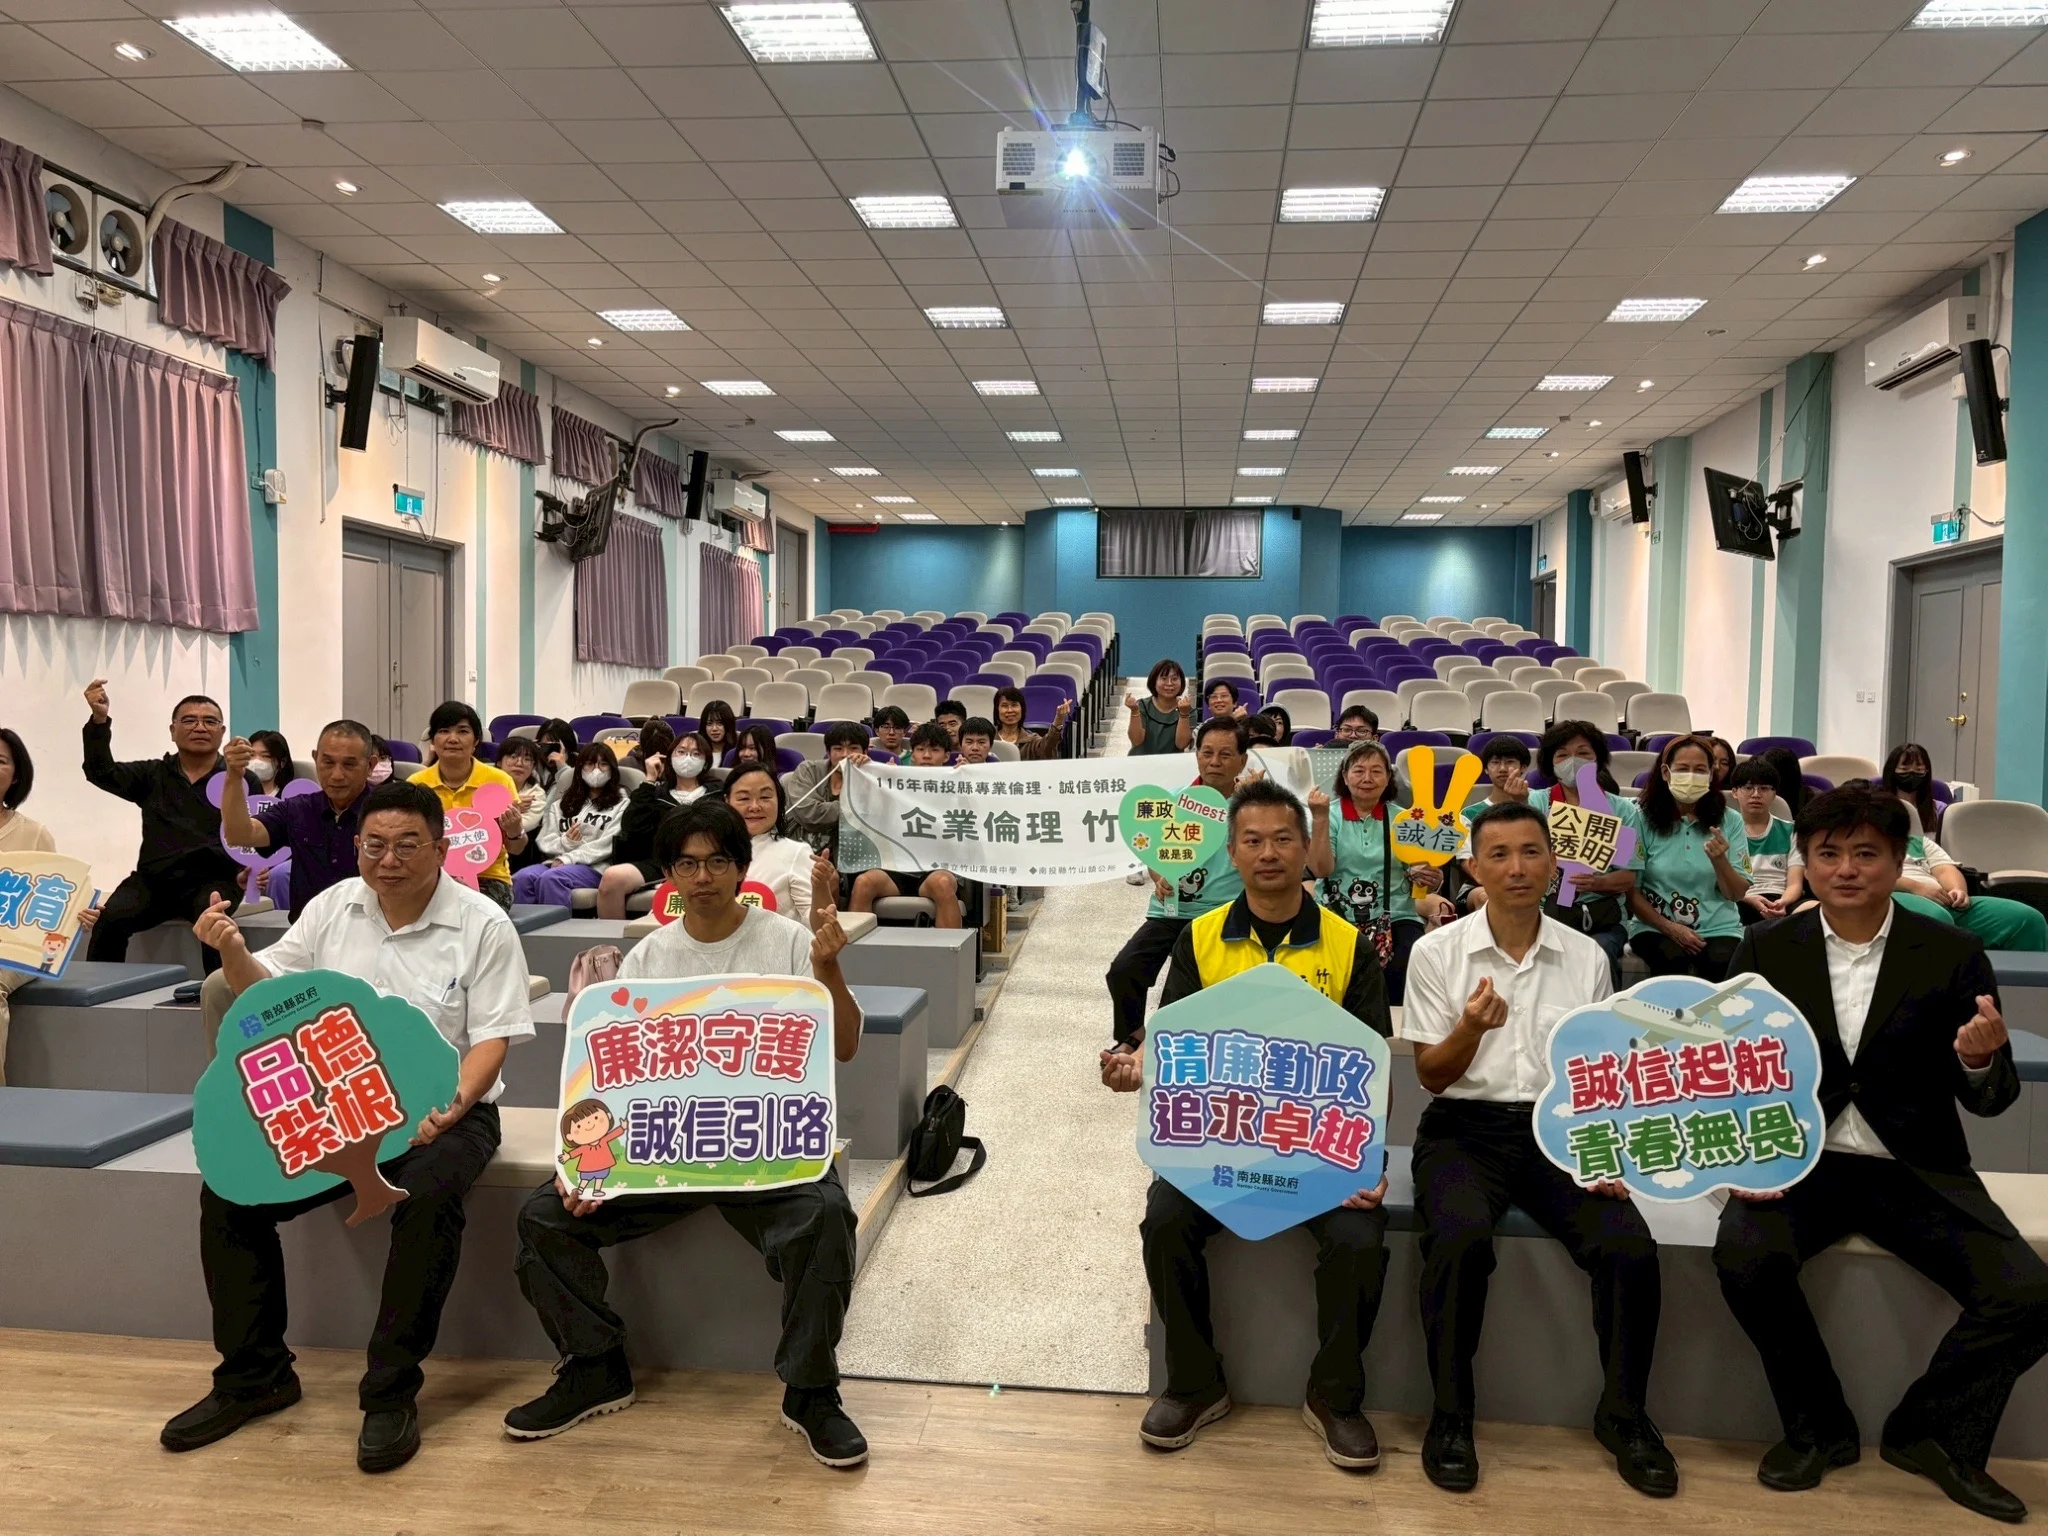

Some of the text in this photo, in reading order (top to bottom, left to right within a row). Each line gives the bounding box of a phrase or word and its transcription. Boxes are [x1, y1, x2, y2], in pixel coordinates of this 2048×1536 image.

[900, 806, 1120, 845] 企業倫理 竹
[1135, 800, 1174, 819] 廉政
[1177, 793, 1227, 822] Honest
[1551, 805, 1619, 844] 公開
[1164, 822, 1202, 842] 大使
[1396, 821, 1461, 852] 誠信
[1550, 831, 1616, 872] 透明
[1158, 848, 1194, 861] 就是我
[261, 986, 318, 1022] 南投縣政府
[241, 1007, 376, 1117] 品德
[589, 1012, 816, 1089] 廉潔守護
[1156, 1032, 1372, 1107] 清廉勤政
[1566, 1036, 1791, 1111] 誠信起航
[628, 1095, 831, 1163] 誠信引路
[1153, 1089, 1372, 1169] 追求卓越
[1568, 1102, 1803, 1177] 青春無畏
[1236, 1170, 1299, 1190] 南投縣政府
